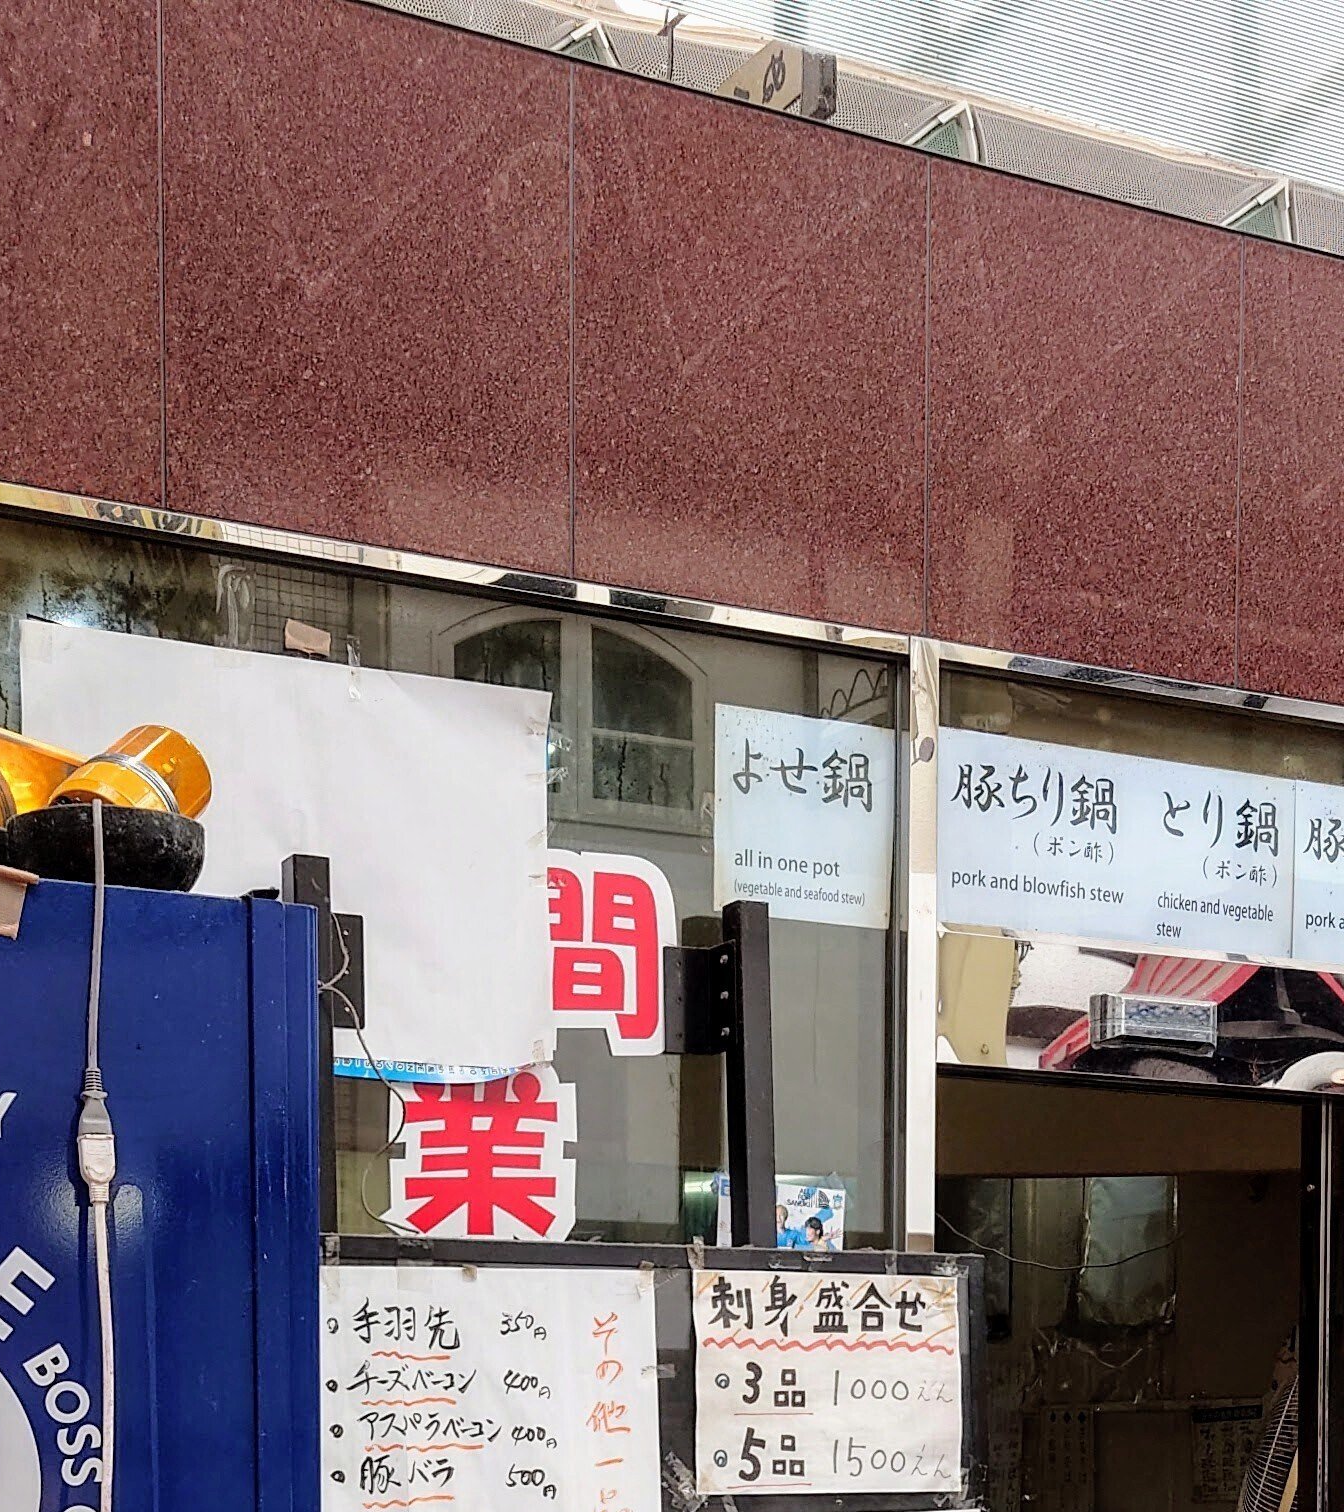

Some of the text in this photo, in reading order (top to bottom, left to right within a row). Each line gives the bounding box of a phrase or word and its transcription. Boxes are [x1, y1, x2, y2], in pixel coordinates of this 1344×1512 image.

[732, 738, 873, 814] よせ鍋
[950, 764, 1118, 835] 豚ちり鍋
[1162, 790, 1279, 857] とり鍋
[734, 849, 840, 879] all in one pot
[951, 869, 1125, 905] pork and blowfish stew
[784, 884, 839, 904] and seafood
[1157, 892, 1274, 925] chicken and vegetable
[1156, 922, 1182, 939] stew
[1305, 911, 1335, 932] pork
[404, 1067, 558, 1236] 業
[352, 1297, 461, 1351] 手羽先
[710, 1274, 927, 1338] 刺身盛合せ
[346, 1360, 478, 1394] チーズベーコン
[741, 1361, 954, 1409] 3品 1000えん
[22, 1342, 103, 1487] BOSS
[356, 1411, 503, 1444] アスパラベーコン
[738, 1427, 952, 1482] 5品 1500えん
[359, 1456, 557, 1500] 豚バラ 500円
